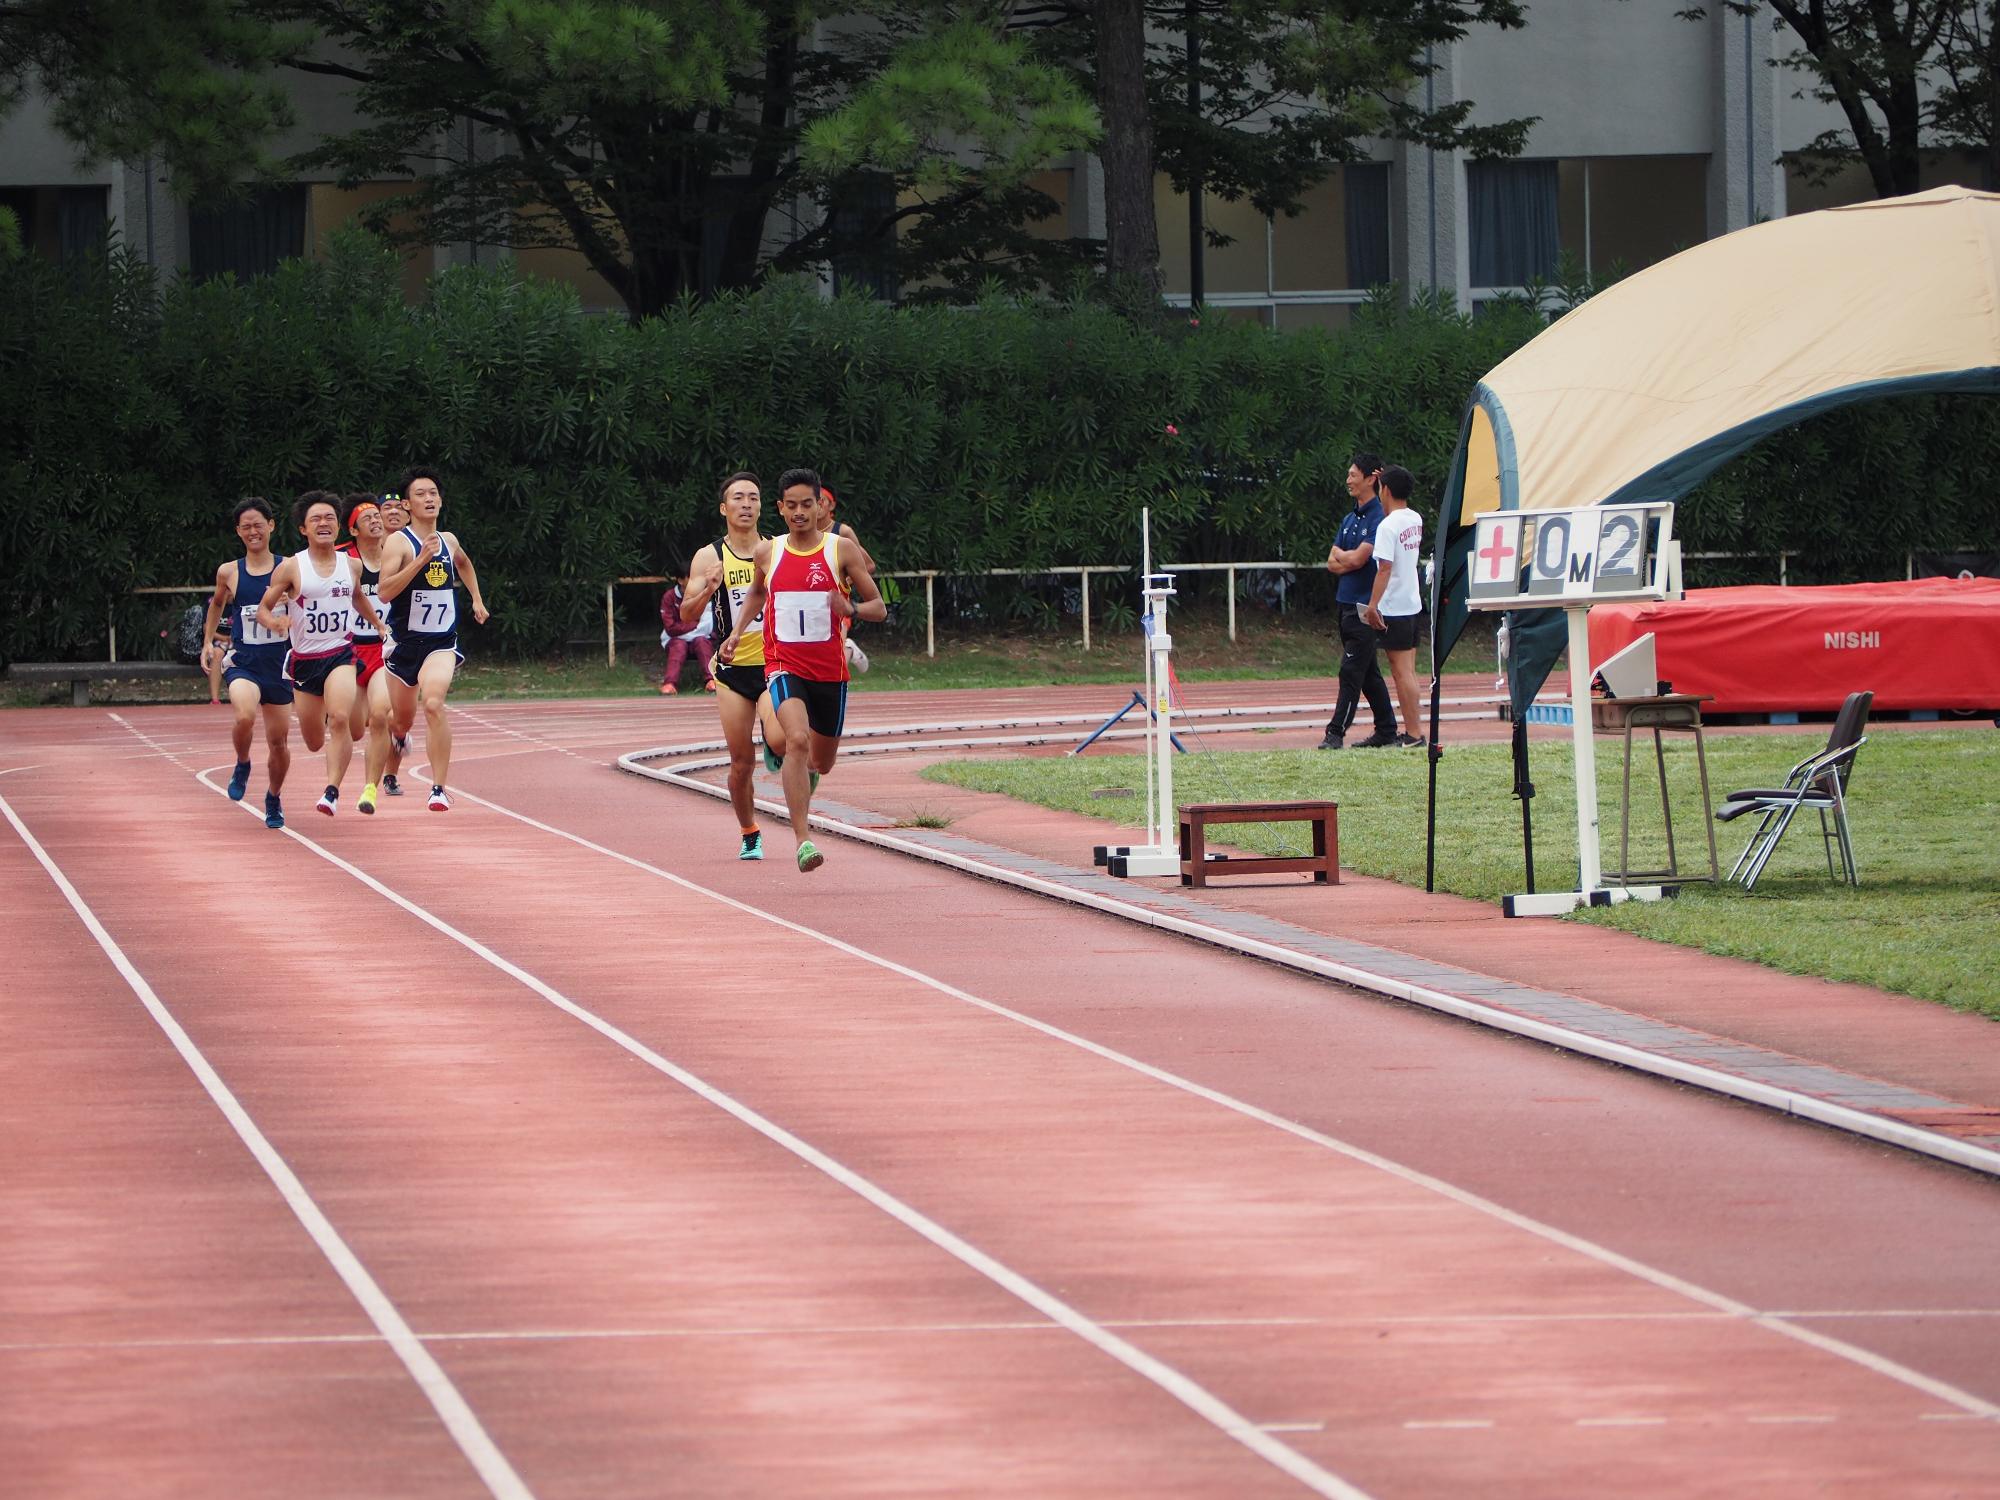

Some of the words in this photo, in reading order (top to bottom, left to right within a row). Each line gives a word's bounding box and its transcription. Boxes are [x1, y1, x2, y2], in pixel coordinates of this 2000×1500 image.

[729, 569, 751, 585] GIFU
[331, 587, 350, 598] 愛知
[414, 592, 428, 603] 5-
[306, 601, 317, 611] J
[421, 603, 448, 625] 77
[305, 610, 349, 633] 3037
[799, 609, 805, 636] 1
[1824, 631, 1880, 649] NISHI
